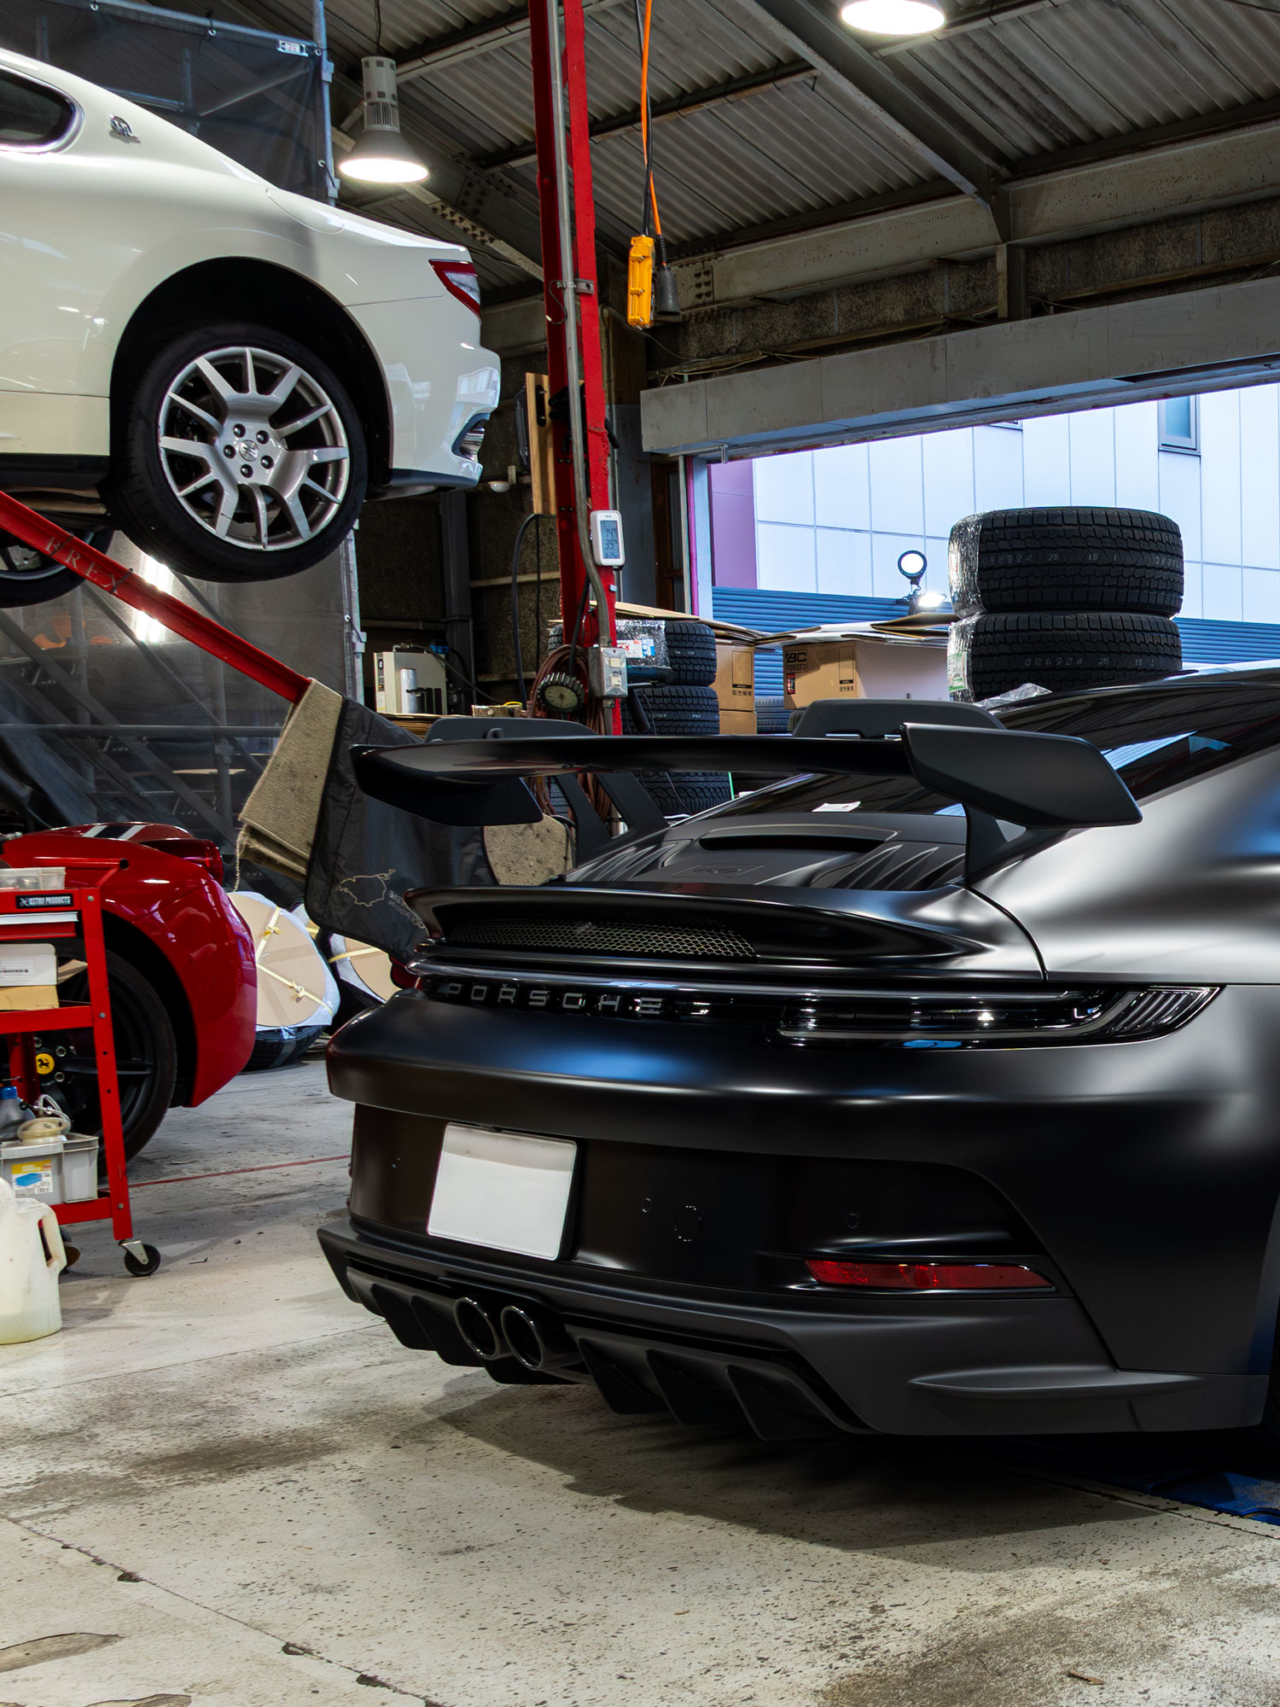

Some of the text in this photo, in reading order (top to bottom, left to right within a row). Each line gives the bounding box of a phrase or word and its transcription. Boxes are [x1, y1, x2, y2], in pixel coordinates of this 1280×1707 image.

[45, 537, 118, 594] BREX
[786, 664, 806, 672] FORGED
[28, 896, 71, 906] ASTRO PRODUCTS
[447, 983, 663, 1015] PORSCHE
